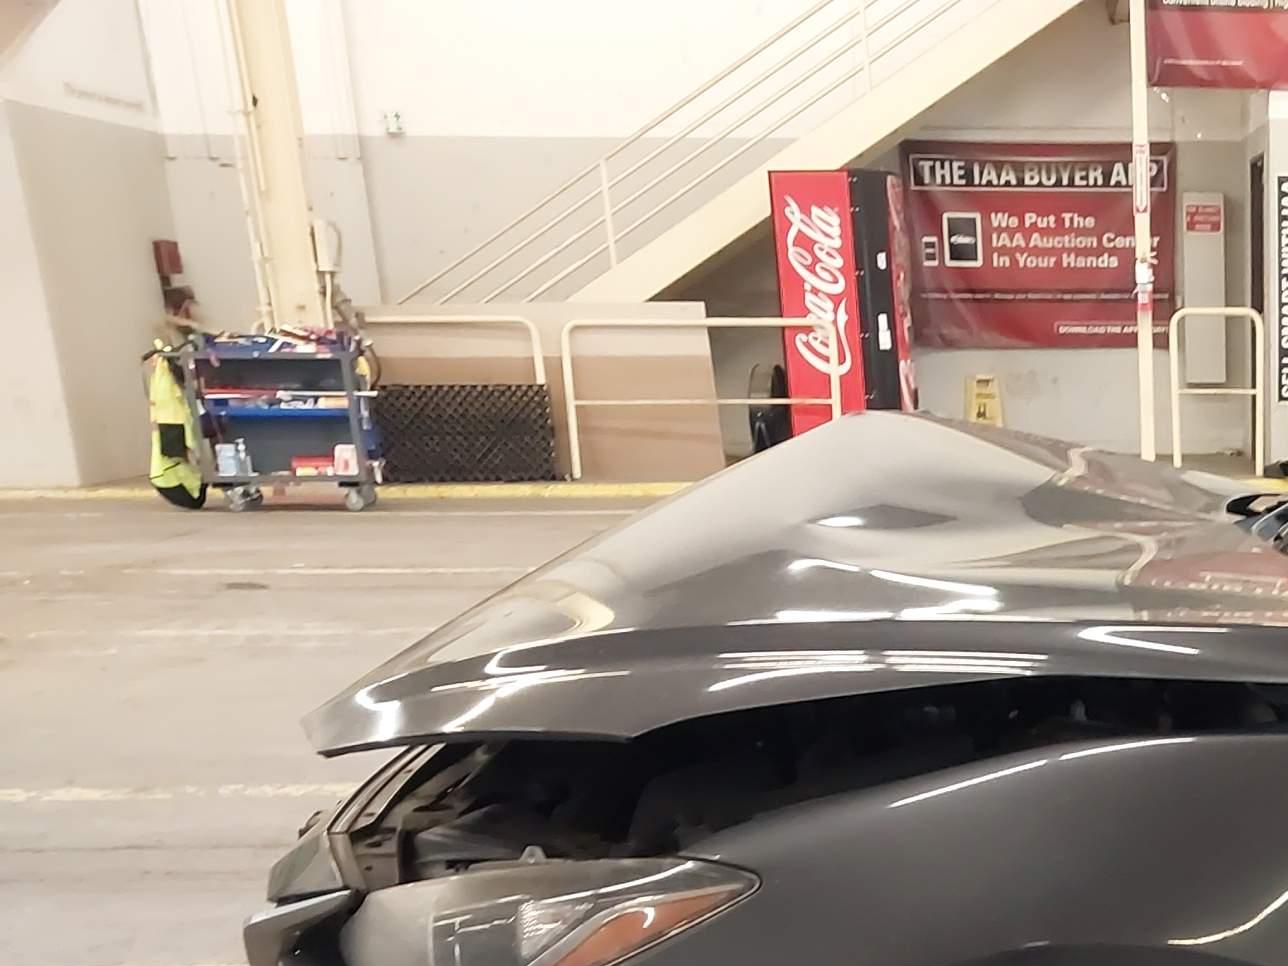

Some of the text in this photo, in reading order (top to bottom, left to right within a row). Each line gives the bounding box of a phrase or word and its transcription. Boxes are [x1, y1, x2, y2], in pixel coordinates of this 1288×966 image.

[918, 160, 966, 185] THE
[973, 161, 1017, 186] IAA
[1023, 162, 1104, 187] BUYER
[990, 212, 1096, 229] We Put The
[991, 232, 1160, 248] IAA Auction Cenr
[992, 252, 1119, 268] In Your Hands
